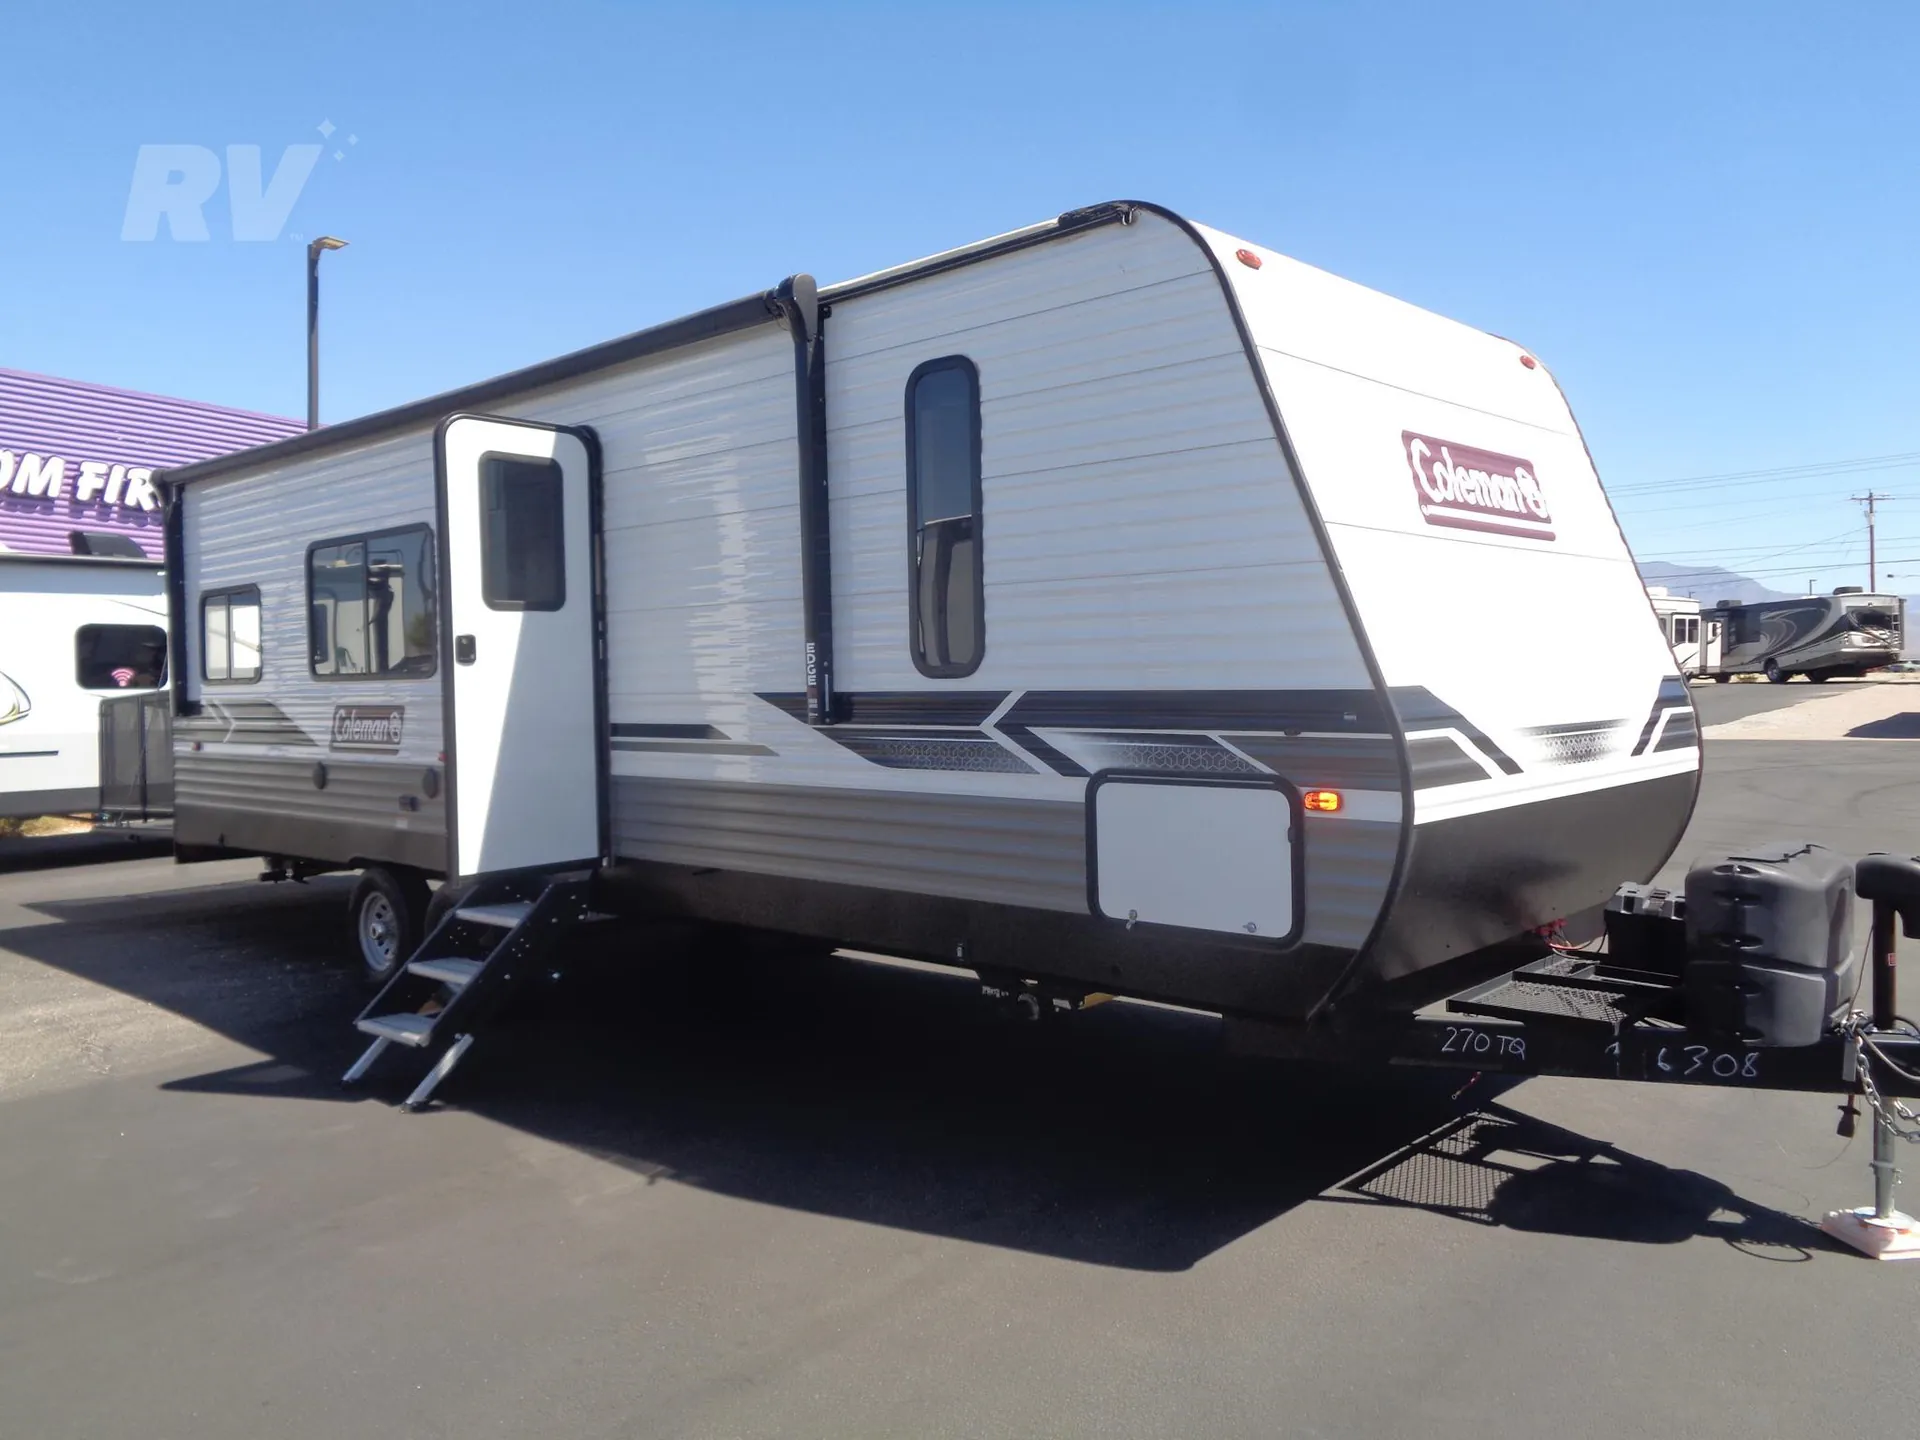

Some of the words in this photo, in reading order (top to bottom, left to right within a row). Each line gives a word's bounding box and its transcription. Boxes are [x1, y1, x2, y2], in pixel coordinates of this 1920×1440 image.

[1410, 438, 1528, 514] Coleman
[806, 642, 817, 686] EDGE
[335, 709, 389, 742] Coleman
